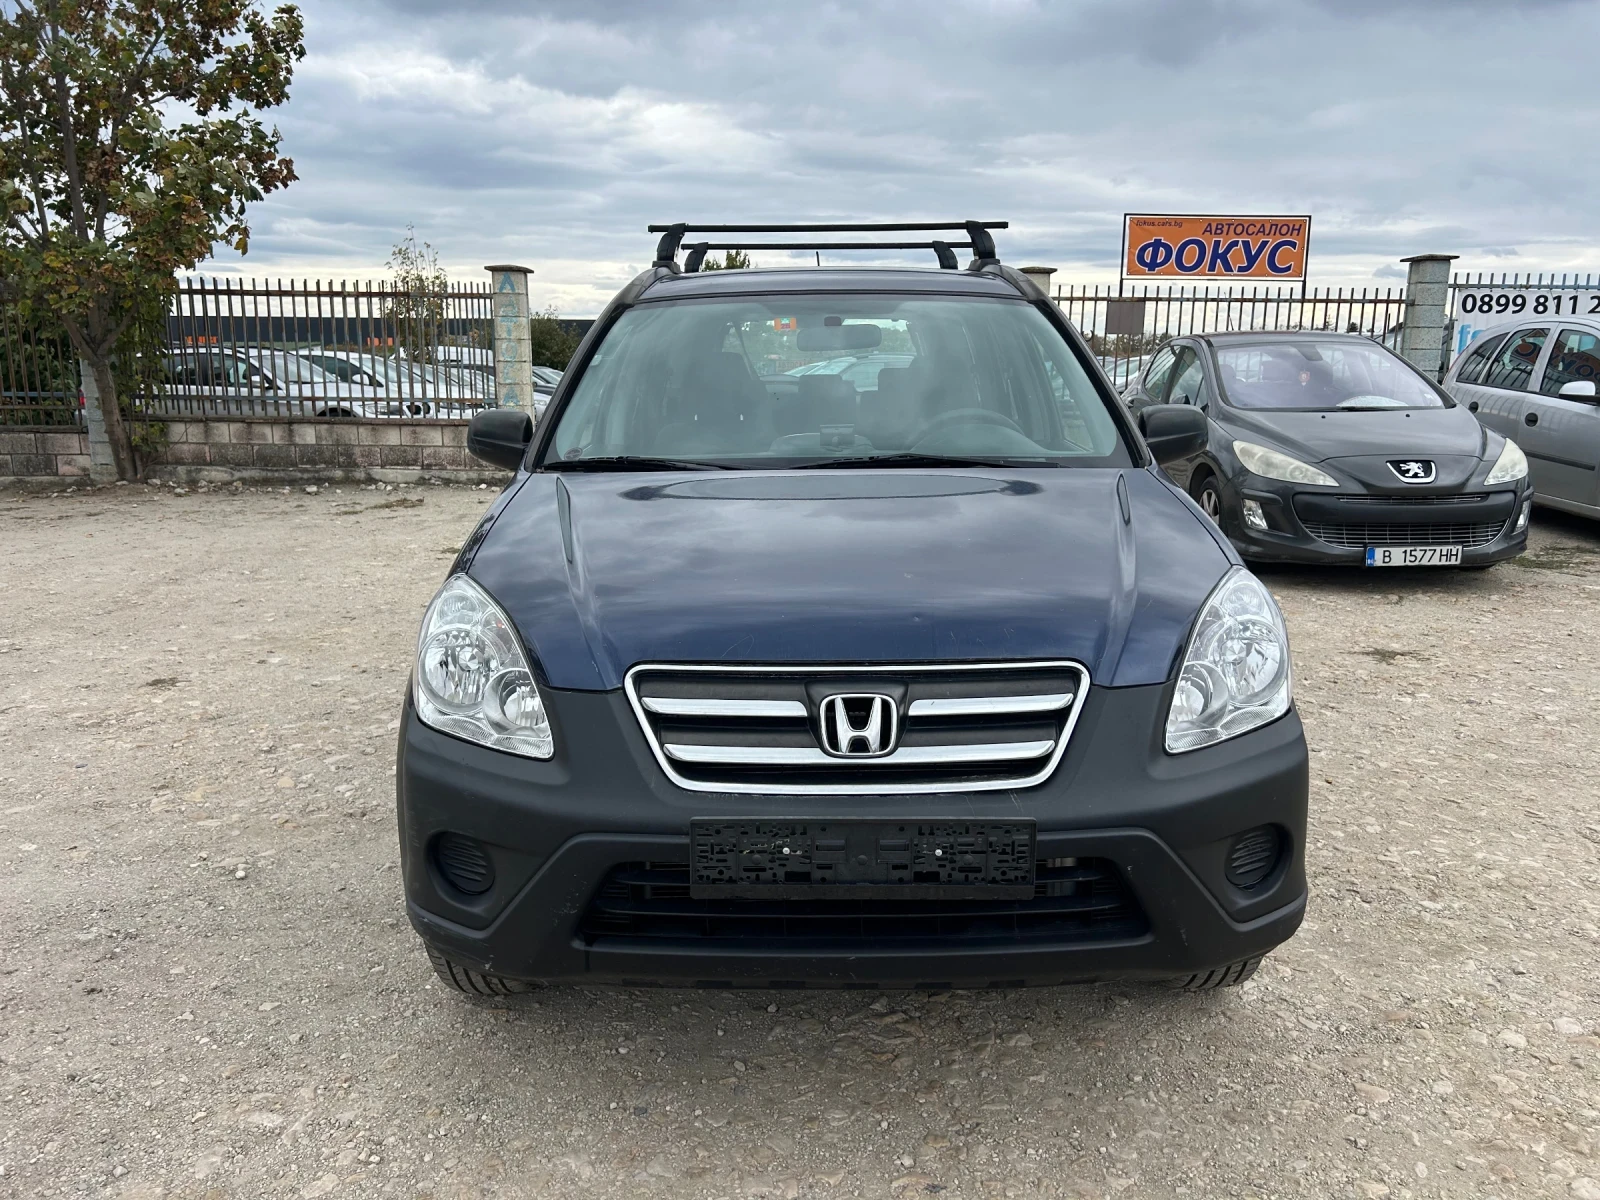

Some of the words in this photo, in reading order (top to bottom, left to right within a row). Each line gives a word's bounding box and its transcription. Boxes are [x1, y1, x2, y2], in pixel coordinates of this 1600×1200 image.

[1202, 222, 1302, 236] АВТОСАЛОН
[1135, 237, 1299, 273] ФОКУС
[1461, 294, 1527, 314] 0899
